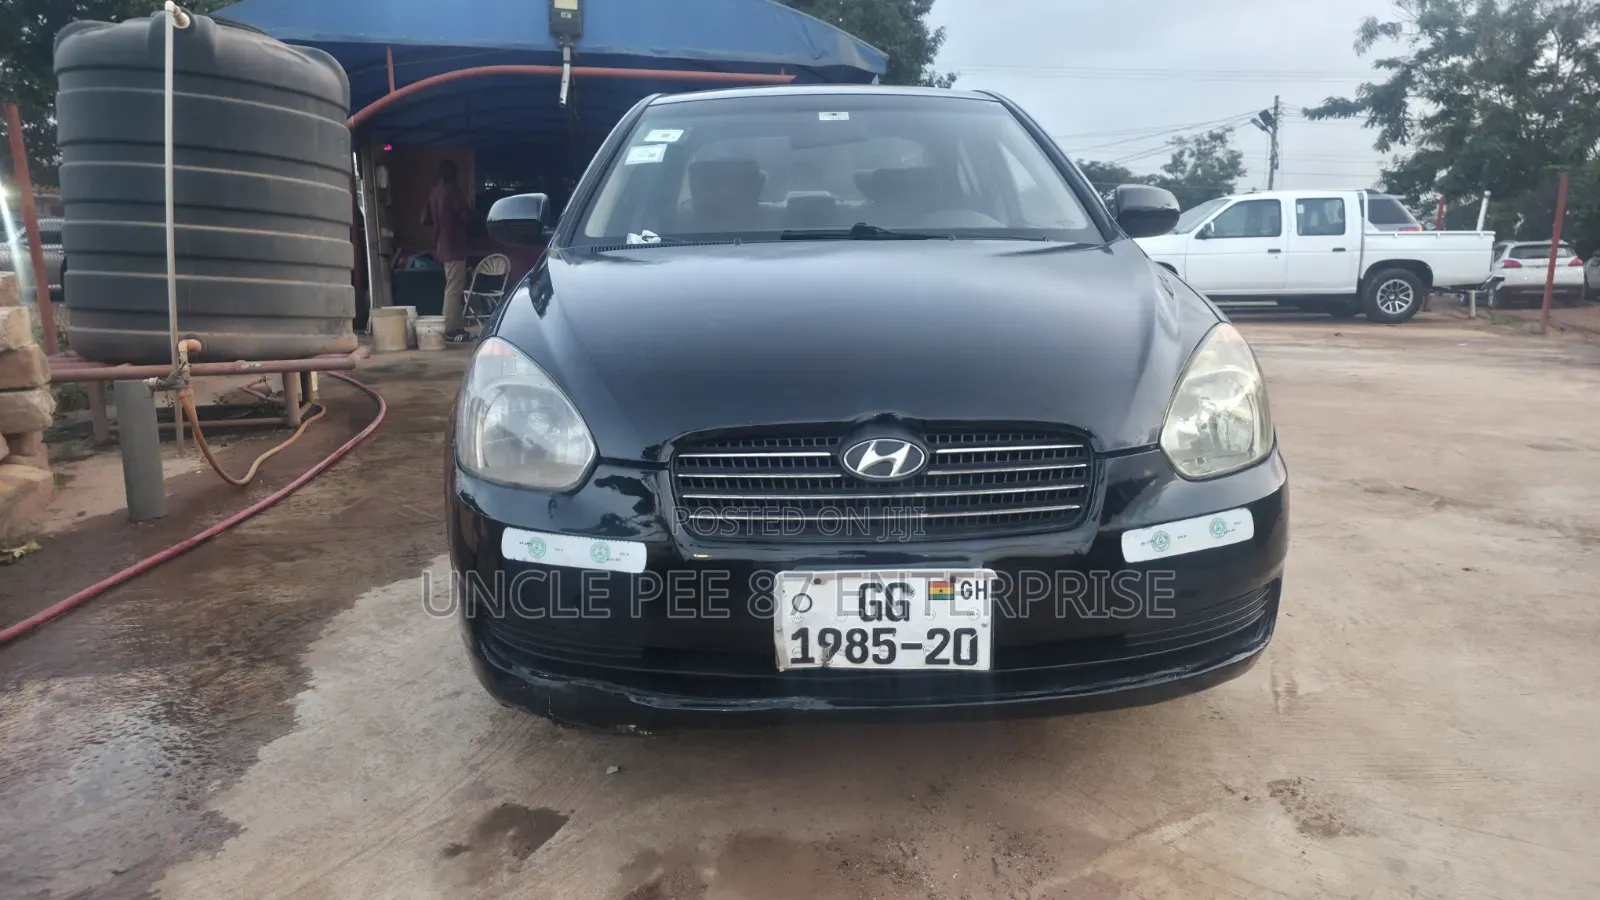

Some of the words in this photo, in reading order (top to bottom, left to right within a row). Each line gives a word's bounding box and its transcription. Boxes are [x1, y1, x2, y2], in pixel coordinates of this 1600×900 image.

[858, 581, 910, 622] GG
[960, 580, 988, 600] GH
[790, 626, 978, 666] 1985-20
